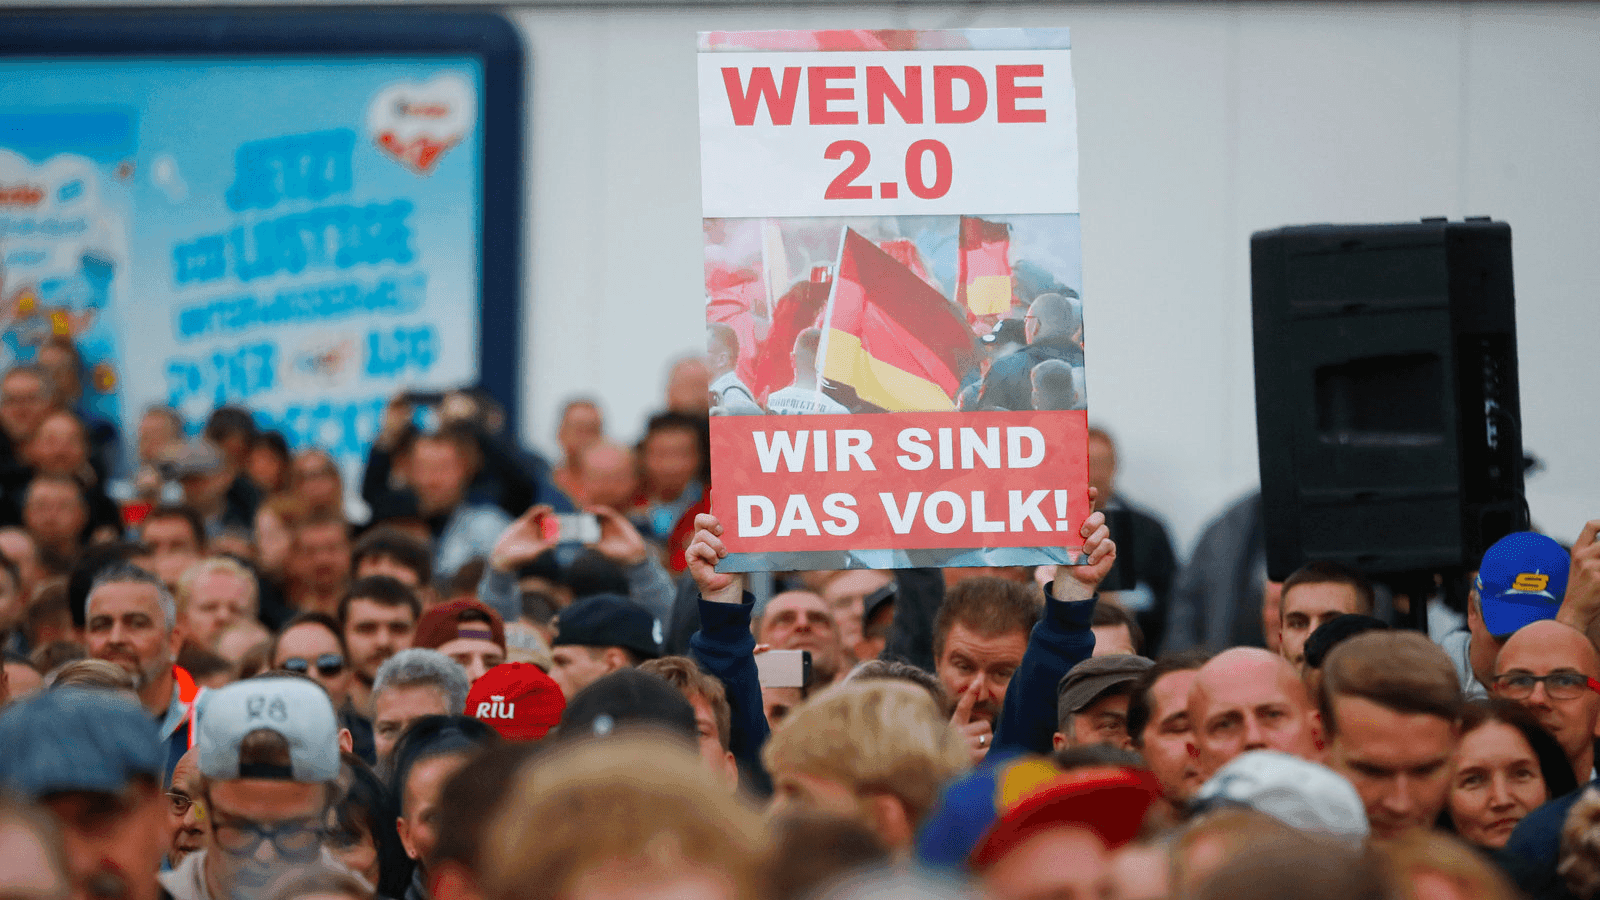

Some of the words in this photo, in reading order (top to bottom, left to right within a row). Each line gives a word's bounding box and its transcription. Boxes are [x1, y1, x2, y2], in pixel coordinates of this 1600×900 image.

[721, 64, 1047, 126] WENDE
[823, 138, 953, 200] 2.0
[752, 429, 877, 473] WIR
[896, 426, 1046, 471] SIND
[736, 492, 860, 538] DAS
[878, 489, 1069, 535] VOLK!
